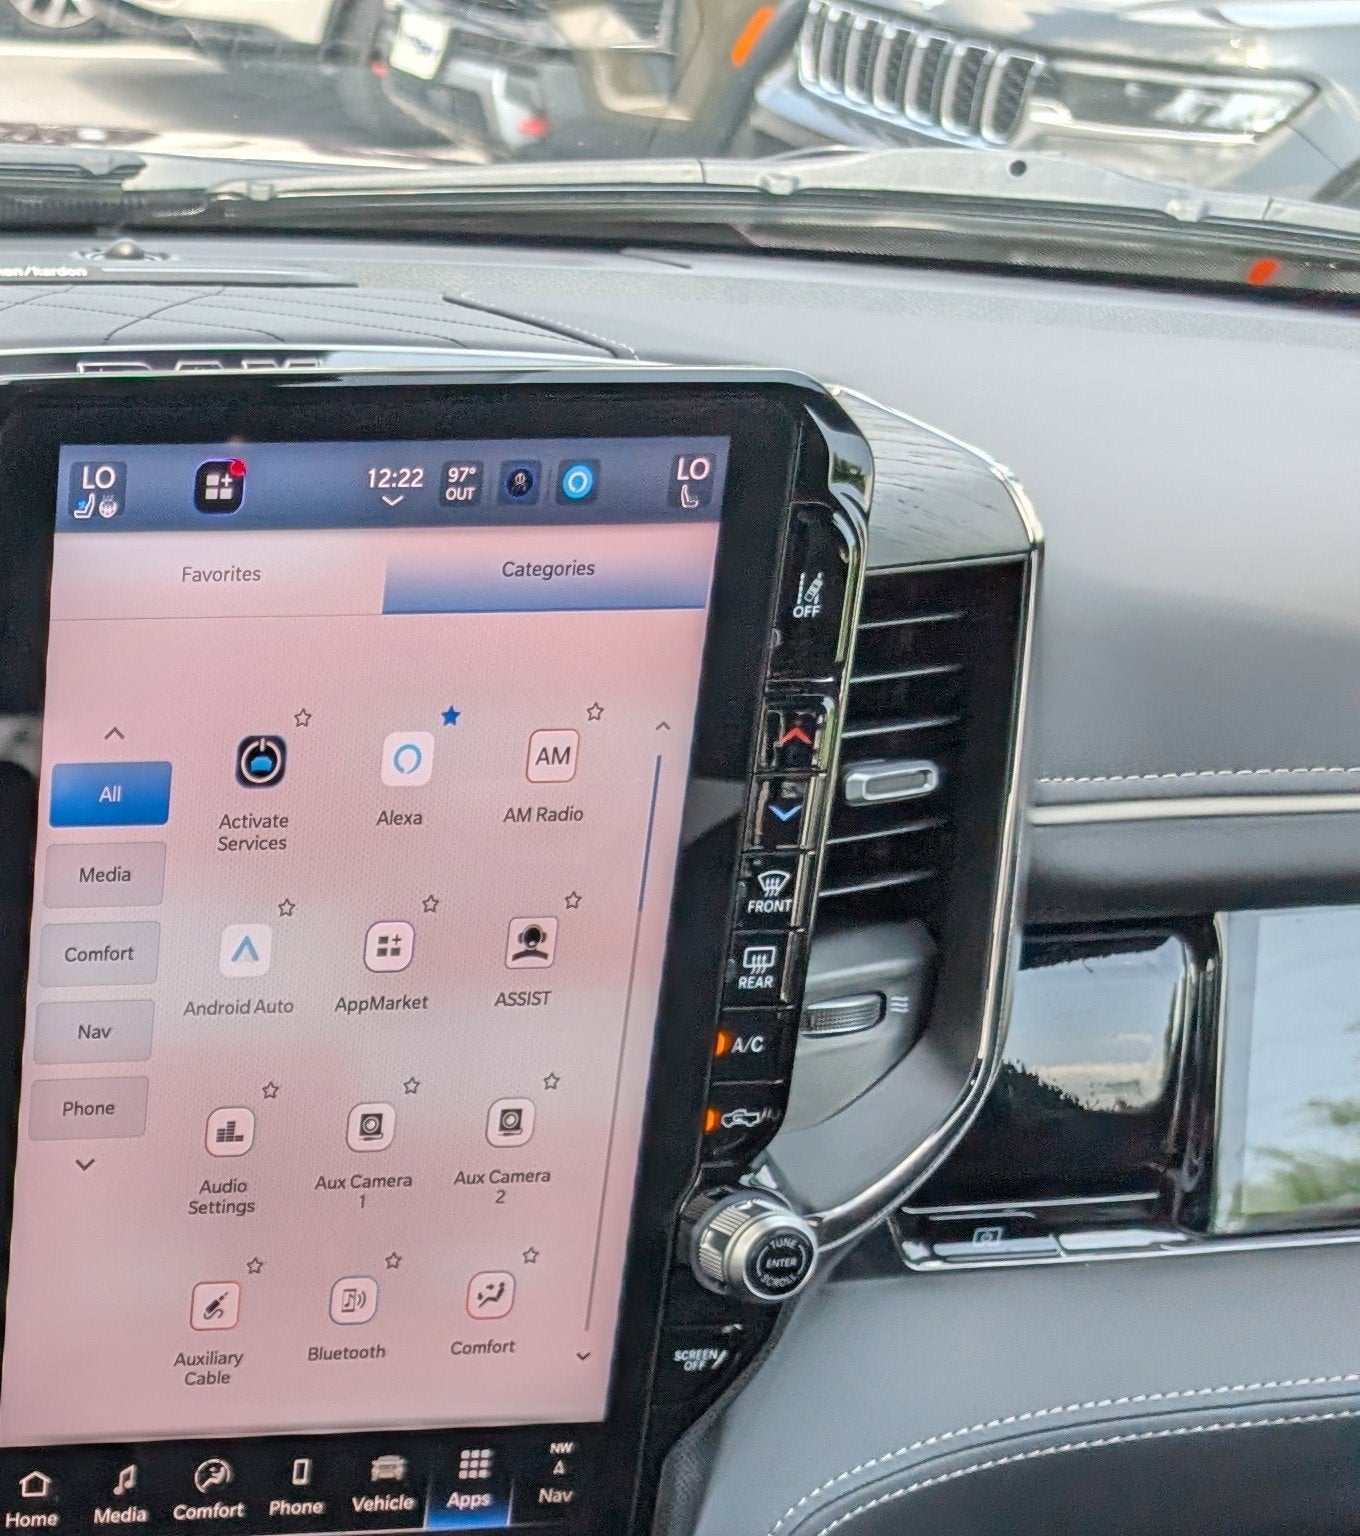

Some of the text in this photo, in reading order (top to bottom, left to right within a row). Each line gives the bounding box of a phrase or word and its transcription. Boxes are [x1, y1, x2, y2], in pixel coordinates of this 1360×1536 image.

[677, 457, 710, 481] LO
[82, 466, 116, 490] LO
[368, 468, 424, 488] 12:22
[445, 487, 476, 501] OUT
[182, 565, 262, 583] Favorites
[502, 559, 596, 580] Categories
[792, 605, 821, 618] OFF
[535, 745, 571, 765] AM
[98, 786, 122, 803] All
[219, 813, 289, 829] Activate
[376, 809, 423, 826] Alexa
[503, 805, 584, 823] AM Radio
[217, 835, 287, 851] Services
[79, 866, 131, 883] Media
[747, 898, 792, 914] FRONT
[64, 946, 134, 963] Comfort
[738, 975, 775, 990] REAR
[183, 999, 294, 1016] Android Auto
[334, 995, 429, 1014] AppMarket
[494, 991, 552, 1007] ASSIST
[78, 1024, 112, 1040] Nav
[731, 1035, 765, 1053] A/C
[62, 1101, 115, 1117] Phone
[199, 1177, 248, 1194] Audio
[314, 1173, 413, 1191] Aux Camera
[453, 1168, 552, 1186] Aux Camera
[359, 1195, 367, 1209] 1
[495, 1189, 507, 1204] 2
[188, 1199, 256, 1217] Settings
[307, 1344, 386, 1361] Bluetooth
[450, 1339, 516, 1356] Comfort
[673, 1348, 718, 1362] SCREEN
[174, 1350, 243, 1367] Auxiliary
[683, 1360, 707, 1372] OFF
[184, 1371, 231, 1386] Cable
[351, 1494, 418, 1512] Vehicle
[446, 1491, 493, 1509] Apps
[538, 1488, 574, 1504] Nav
[93, 1506, 149, 1524] Media
[173, 1502, 246, 1521] Comfort
[269, 1500, 325, 1518] Phone
[5, 1512, 60, 1528] Home
